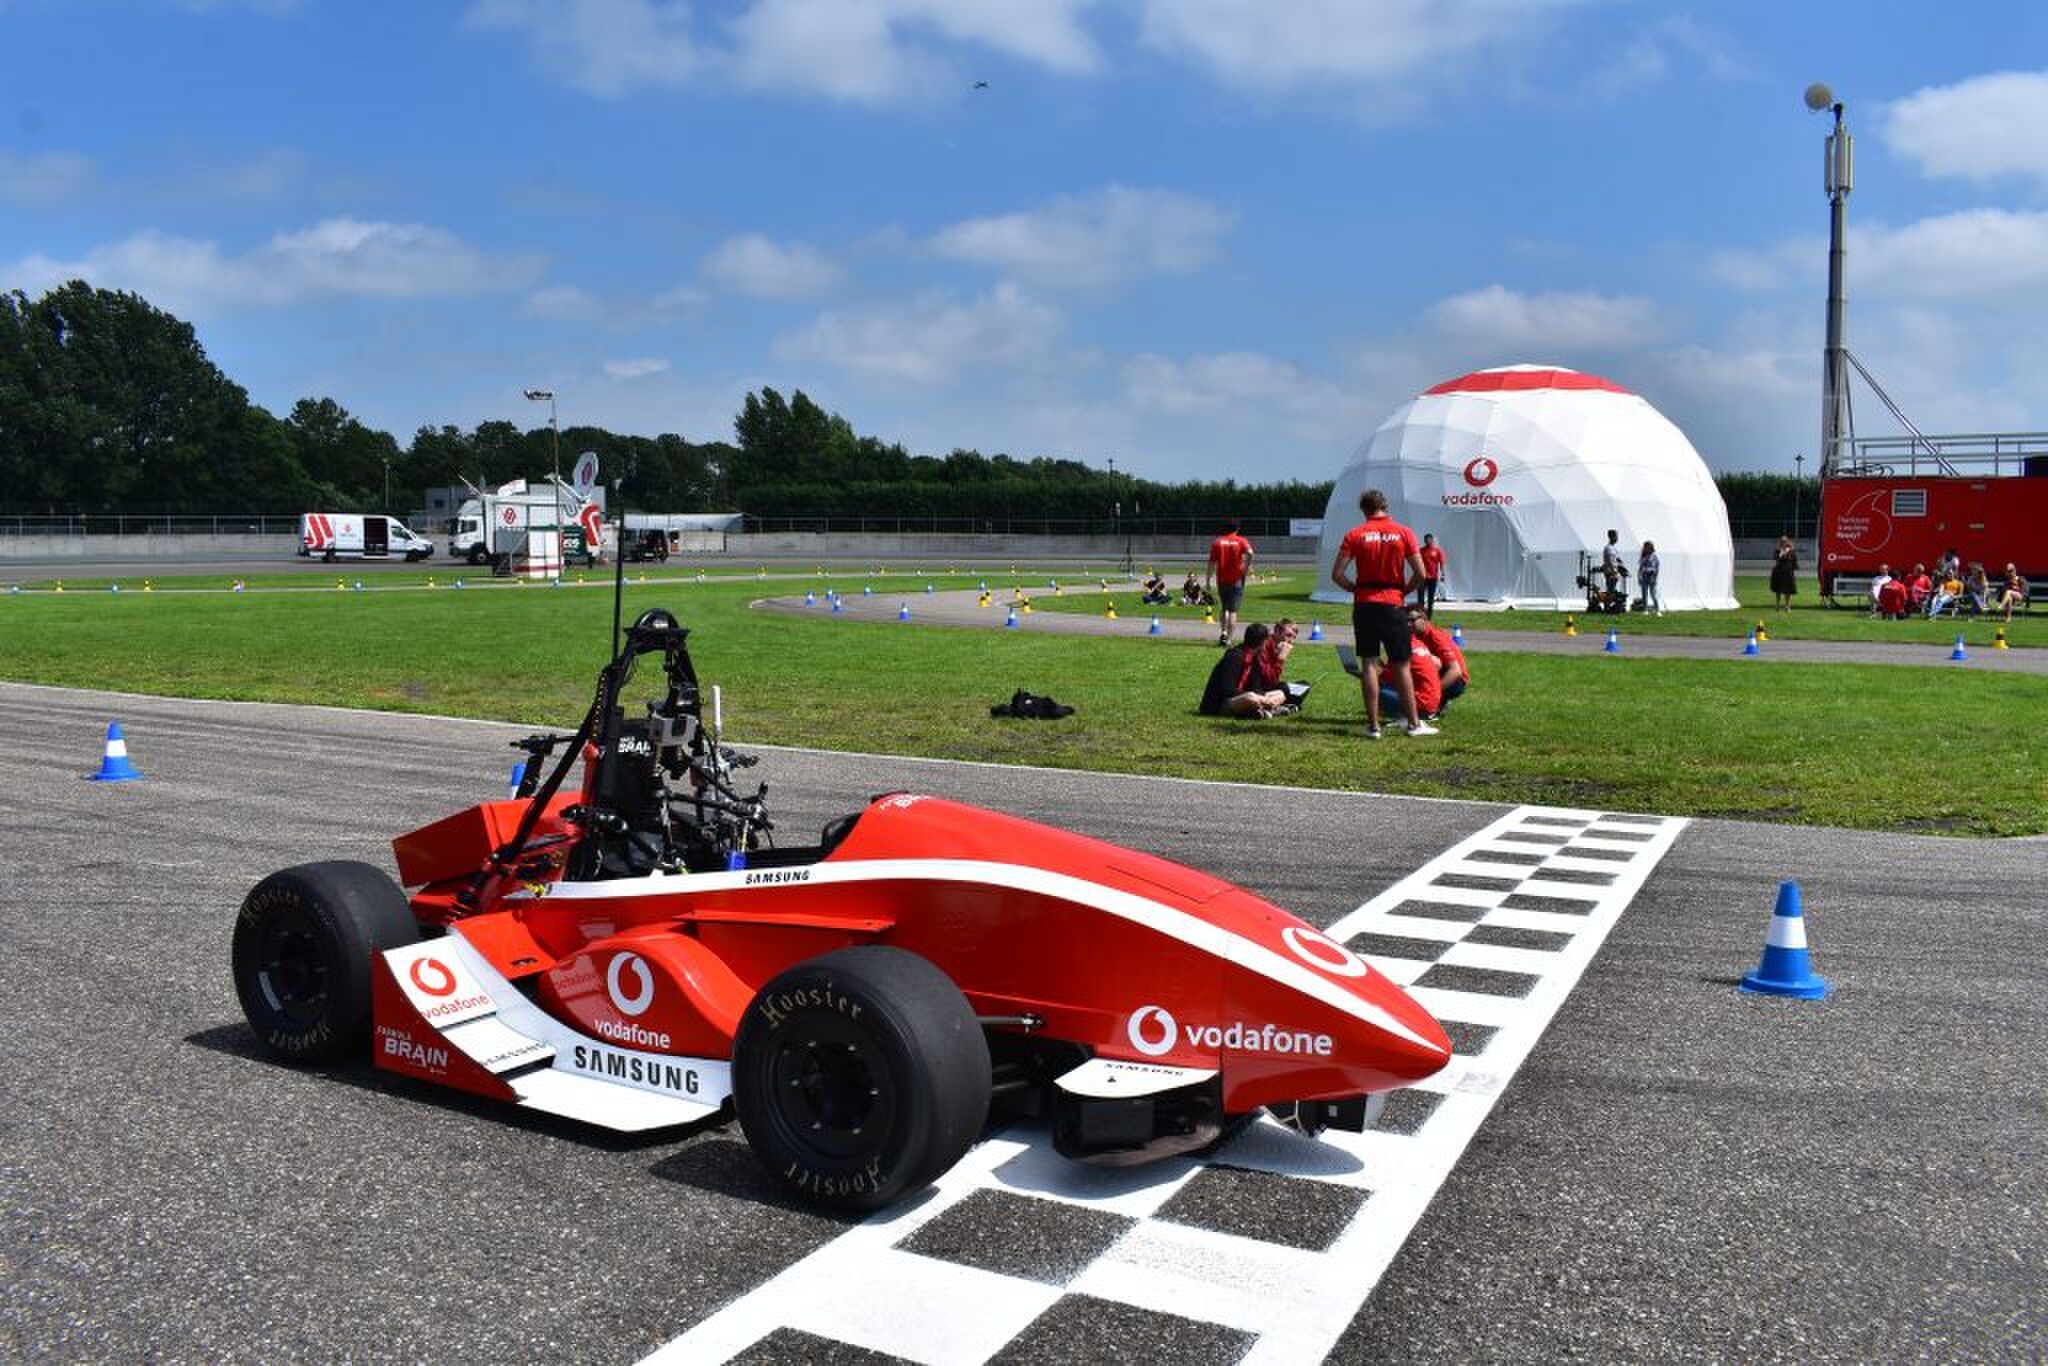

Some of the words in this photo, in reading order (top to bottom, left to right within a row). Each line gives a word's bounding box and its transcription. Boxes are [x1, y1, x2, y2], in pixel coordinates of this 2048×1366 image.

[1441, 491, 1514, 506] vodafone
[745, 870, 811, 885] SAMSUNG
[421, 995, 490, 1018] vodafone
[757, 981, 862, 1029] Hoosier
[593, 1018, 672, 1049] vodafone
[1185, 1022, 1333, 1056] vodafone
[384, 1037, 449, 1068] BRAIN
[575, 1045, 699, 1094] SAMSUNG
[785, 1155, 886, 1196] Hoosier
